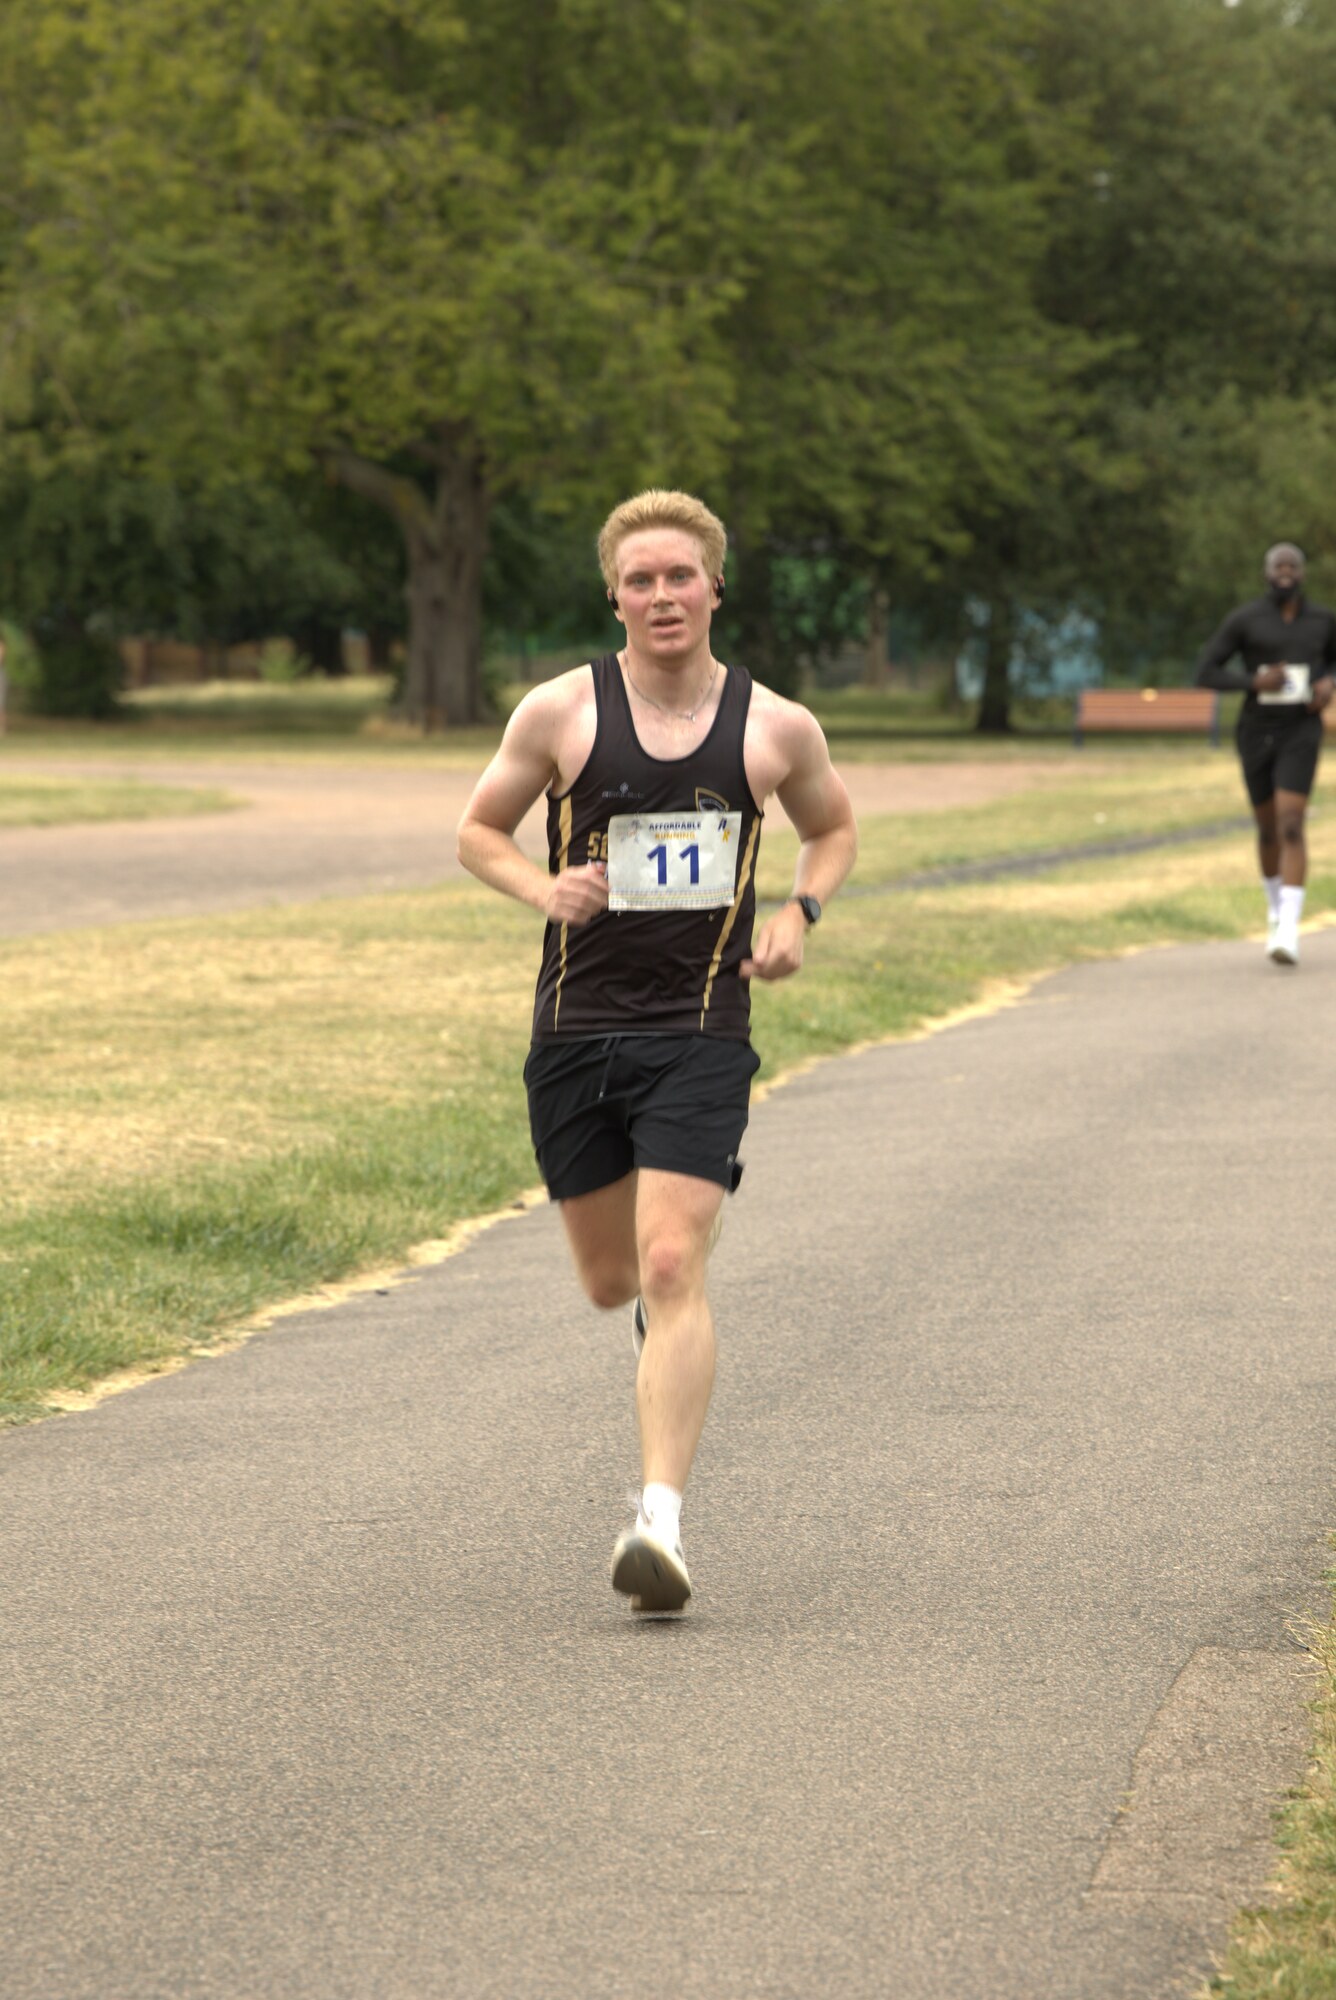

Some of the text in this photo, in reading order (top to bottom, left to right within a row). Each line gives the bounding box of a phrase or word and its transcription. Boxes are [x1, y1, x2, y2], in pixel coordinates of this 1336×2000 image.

[649, 822, 701, 831] AFFORDABLE
[655, 831, 696, 840] RUNNING
[647, 843, 699, 886] 11
